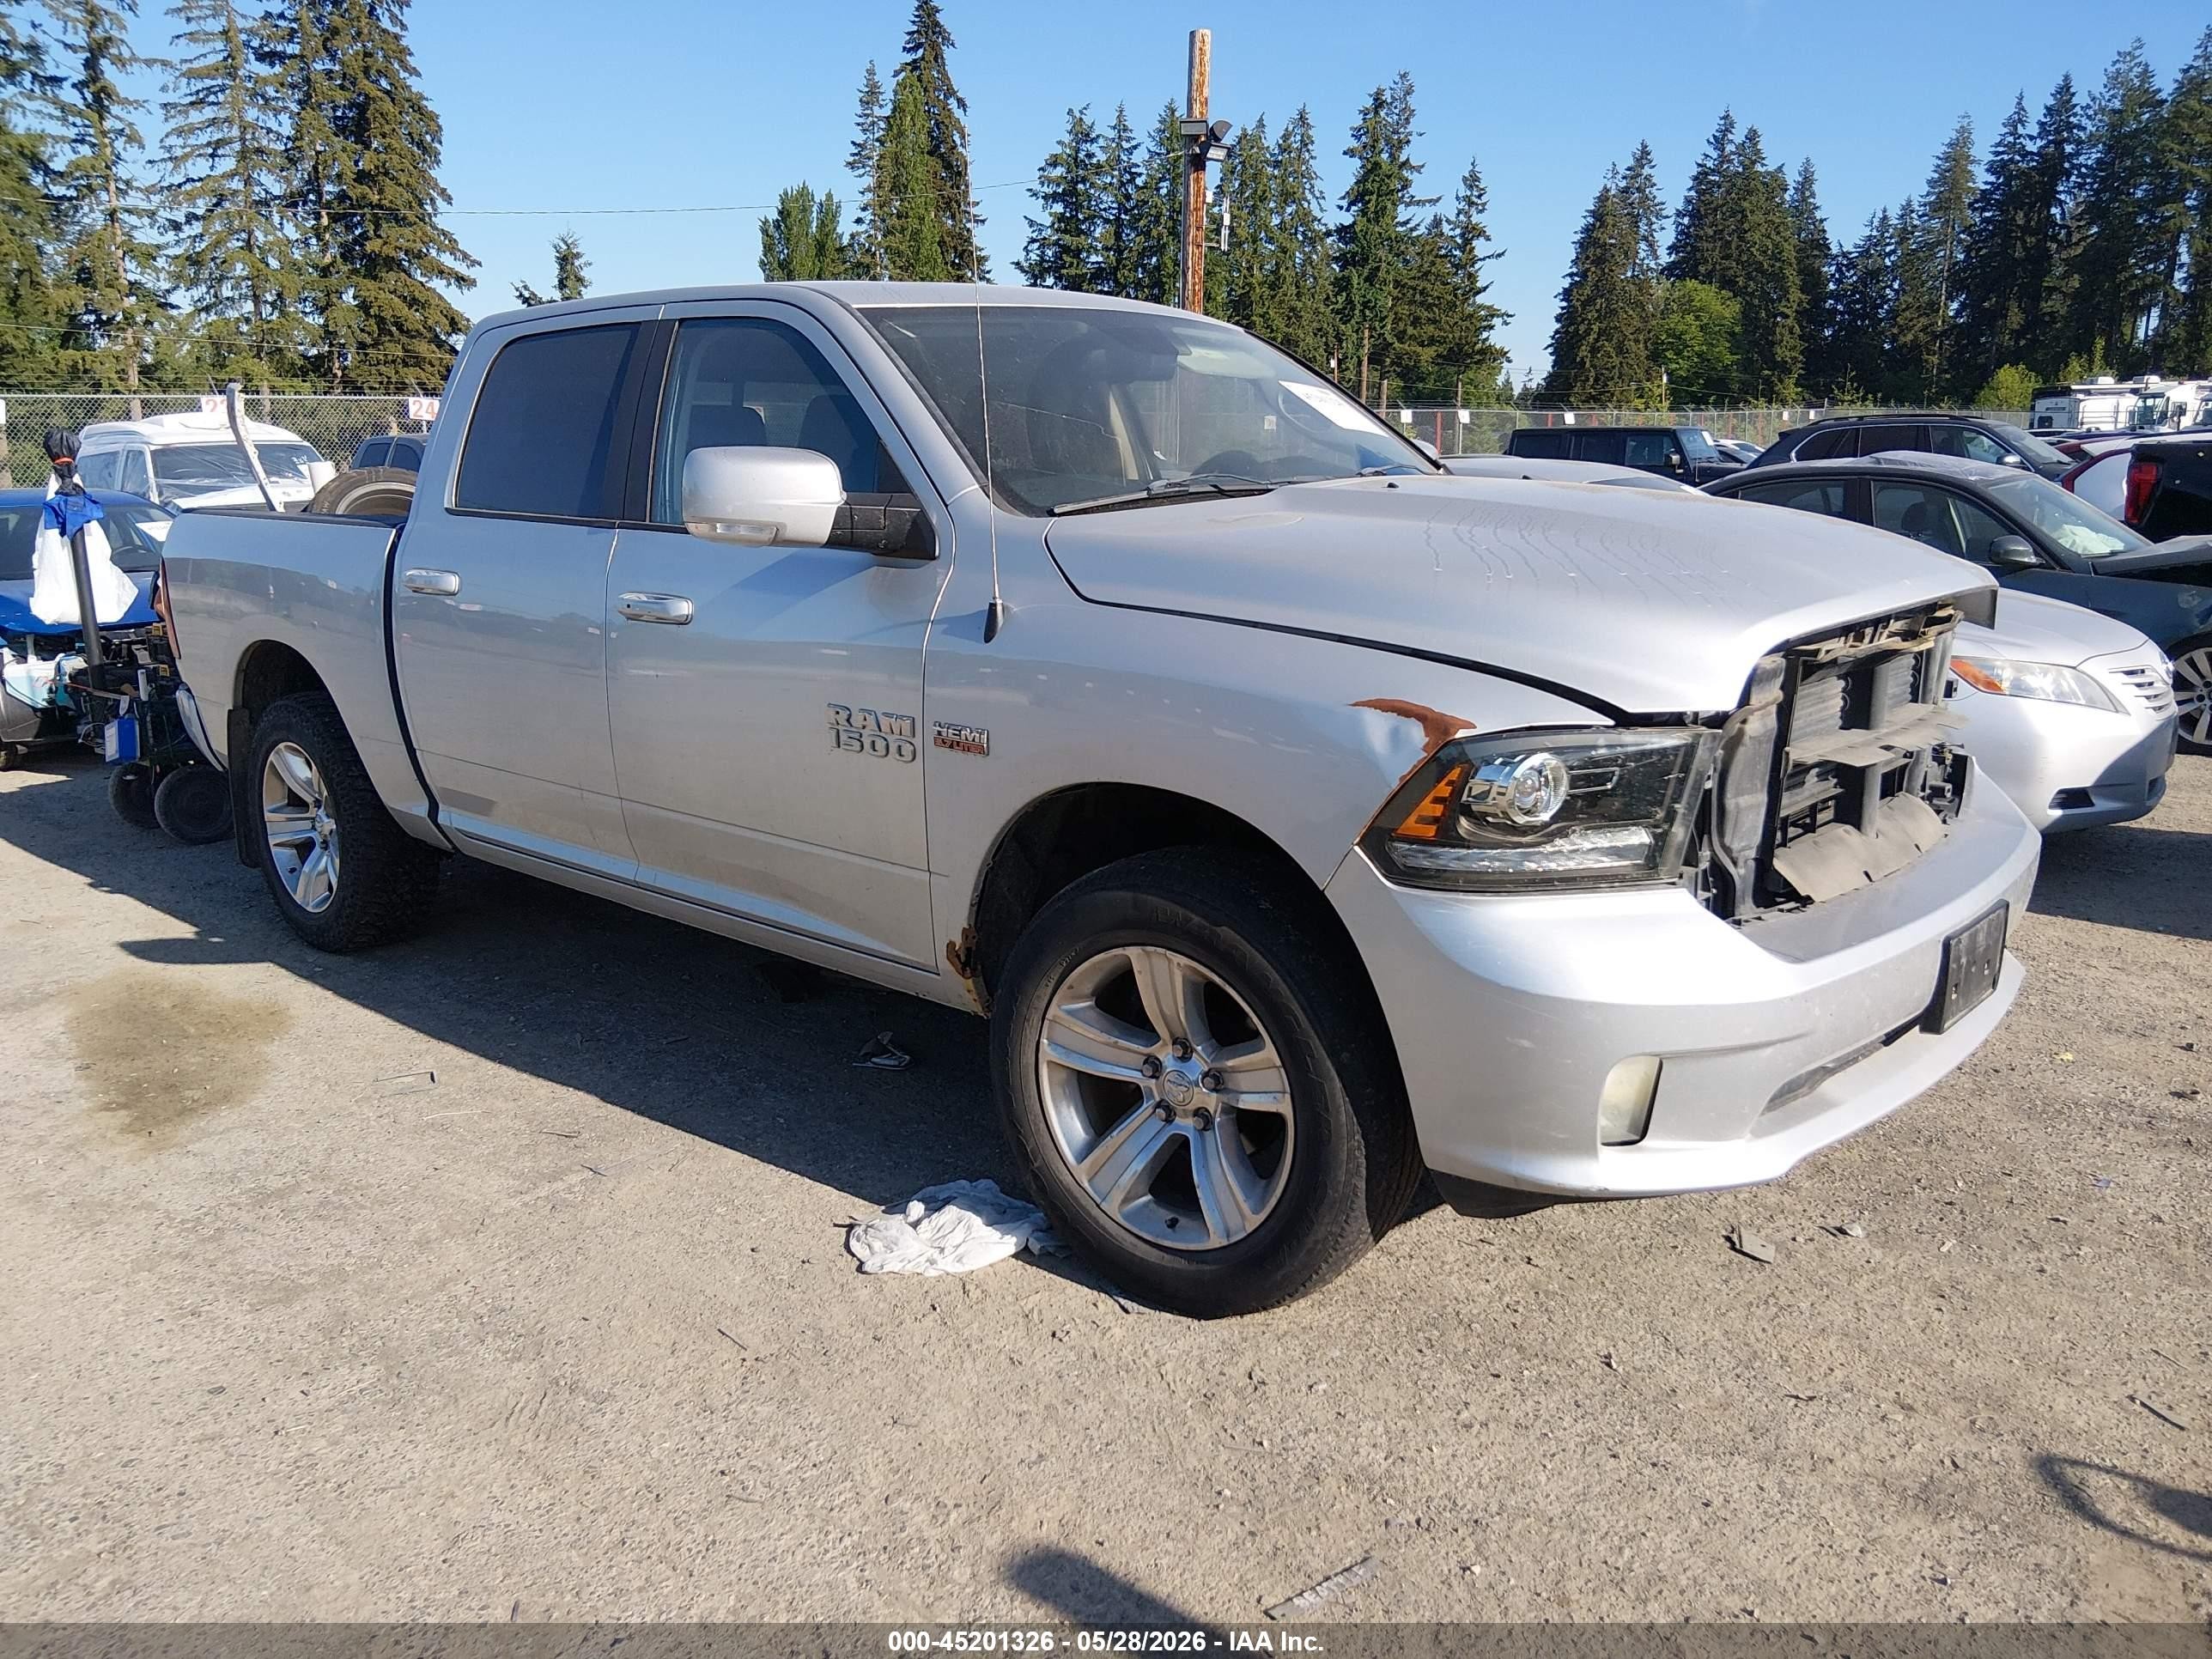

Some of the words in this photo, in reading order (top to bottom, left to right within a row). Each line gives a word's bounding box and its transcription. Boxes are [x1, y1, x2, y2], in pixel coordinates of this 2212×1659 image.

[412, 399, 437, 419] 24
[825, 702, 915, 738] RAM
[933, 721, 989, 744] HEMI
[828, 726, 916, 763] 1500
[953, 741, 985, 755] LITER
